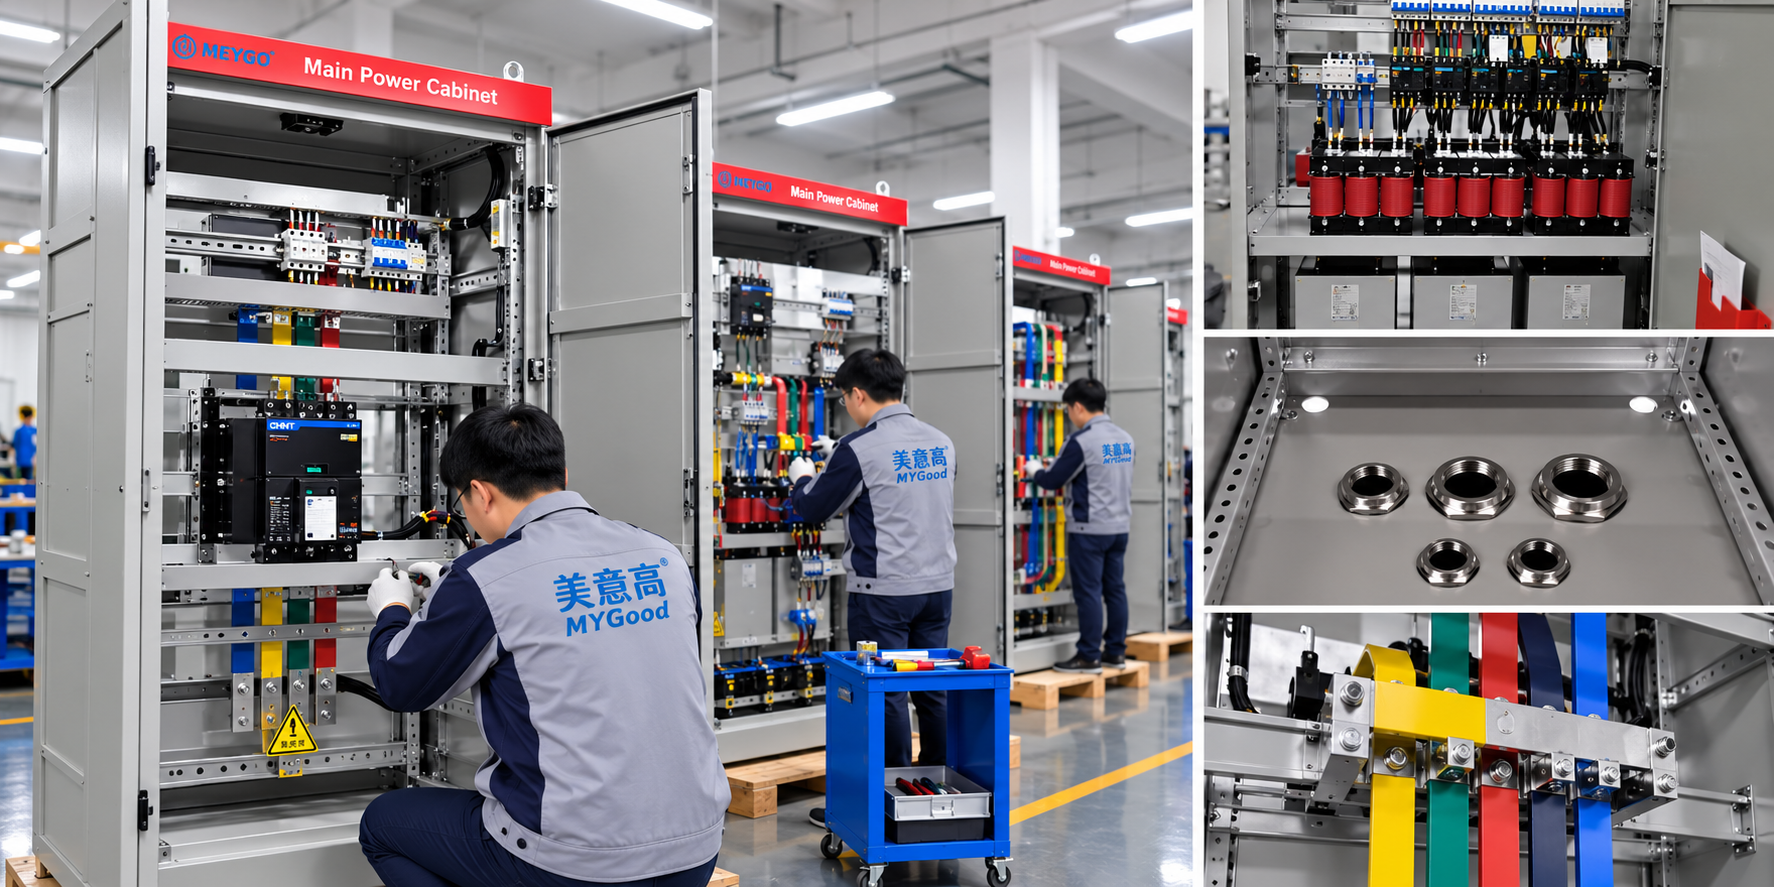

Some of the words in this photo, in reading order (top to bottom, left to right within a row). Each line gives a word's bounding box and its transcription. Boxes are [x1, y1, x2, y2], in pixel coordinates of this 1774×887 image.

[304, 57, 353, 81] Main
[360, 66, 421, 92] Power
[426, 78, 498, 105] Cabinet
[791, 185, 814, 201] Main
[816, 190, 845, 206] Power
[846, 197, 879, 213] Cabinet
[897, 467, 947, 484] MYGood
[566, 600, 670, 637] MYGood
